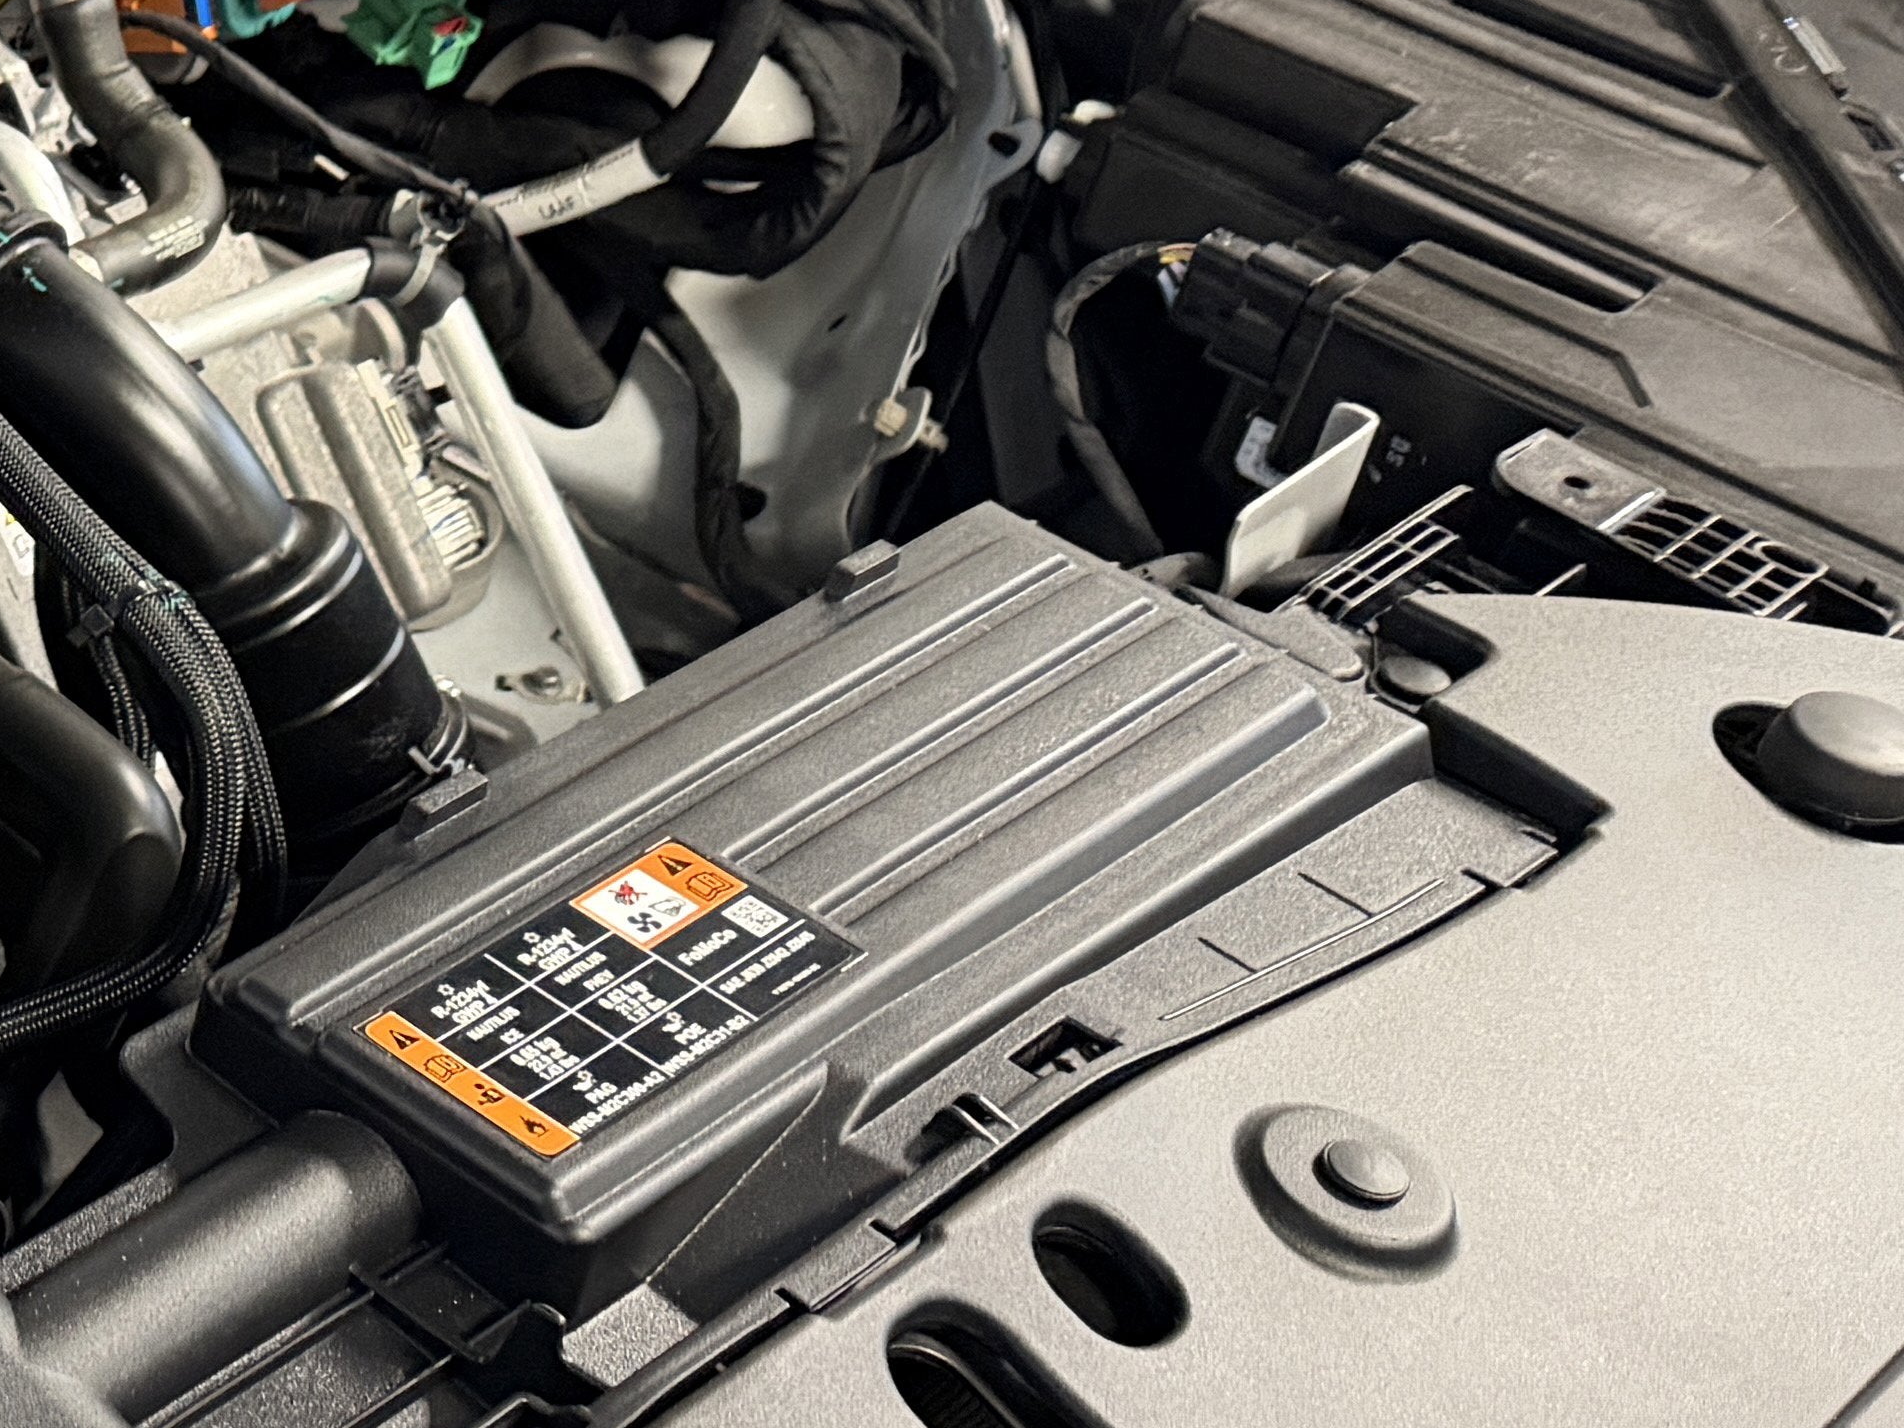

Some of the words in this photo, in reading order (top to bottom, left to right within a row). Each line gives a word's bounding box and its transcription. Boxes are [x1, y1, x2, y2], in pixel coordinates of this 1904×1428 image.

[677, 929, 739, 967] FoMoCo
[553, 951, 608, 986] NAUTILUS
[466, 1006, 521, 1041] NAUTILUS
[500, 1028, 525, 1044] ICE
[674, 1023, 707, 1045] POE
[585, 1081, 618, 1104] PAG
